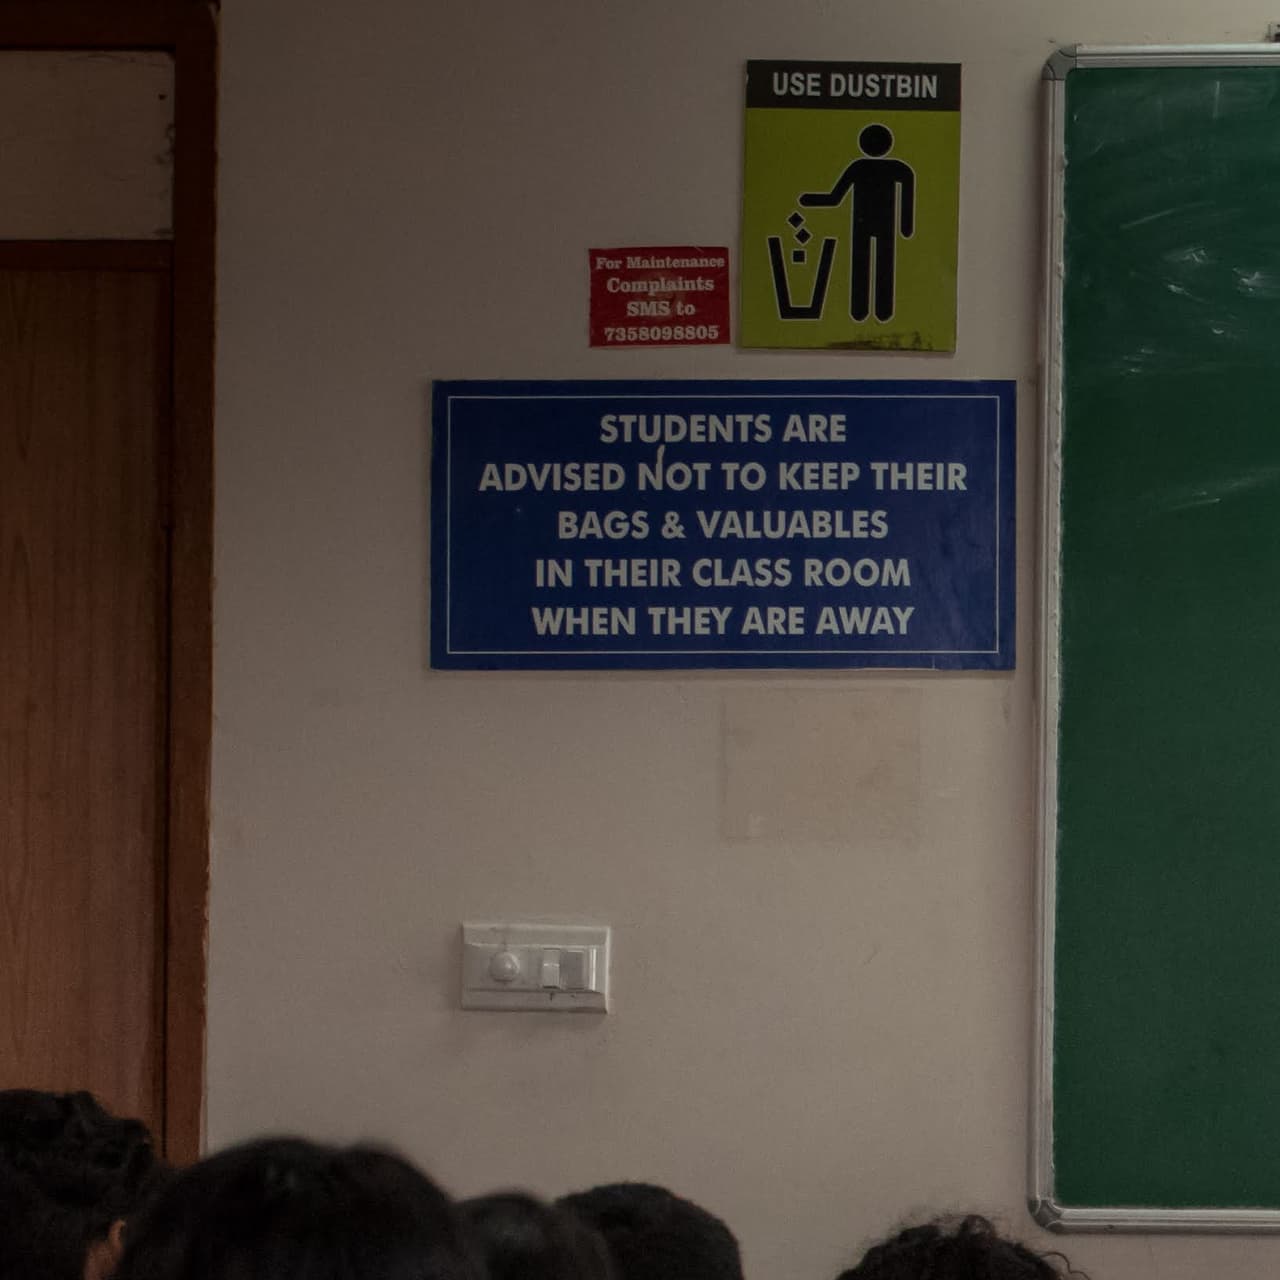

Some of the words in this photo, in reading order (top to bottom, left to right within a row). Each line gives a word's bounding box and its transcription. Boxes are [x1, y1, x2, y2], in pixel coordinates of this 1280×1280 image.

[772, 72, 821, 97] USE
[829, 74, 939, 99] DUSTBIN
[596, 256, 623, 270] For
[626, 255, 725, 270] Maintenance
[606, 276, 715, 296] Complaints
[626, 300, 671, 317] SMS
[676, 300, 696, 316] to
[604, 324, 719, 342] 7358098805
[600, 413, 772, 443] STUDENTS
[782, 414, 847, 443] ARE
[478, 462, 625, 492] ADVISED
[638, 458, 710, 492] NOT
[721, 462, 767, 491] TO
[778, 462, 860, 491] KEEP
[870, 462, 968, 491] THEIR
[558, 510, 649, 540] BAGS
[661, 510, 687, 539] &
[697, 510, 889, 539] VALUABLES
[535, 558, 573, 587] IN
[584, 558, 681, 587] THEIR
[692, 558, 791, 587] CLASS
[804, 558, 911, 587] ROOM
[531, 606, 636, 636] WHEN
[647, 606, 734, 635] THEY
[740, 606, 805, 635] ARE
[815, 606, 915, 636] AWAY
